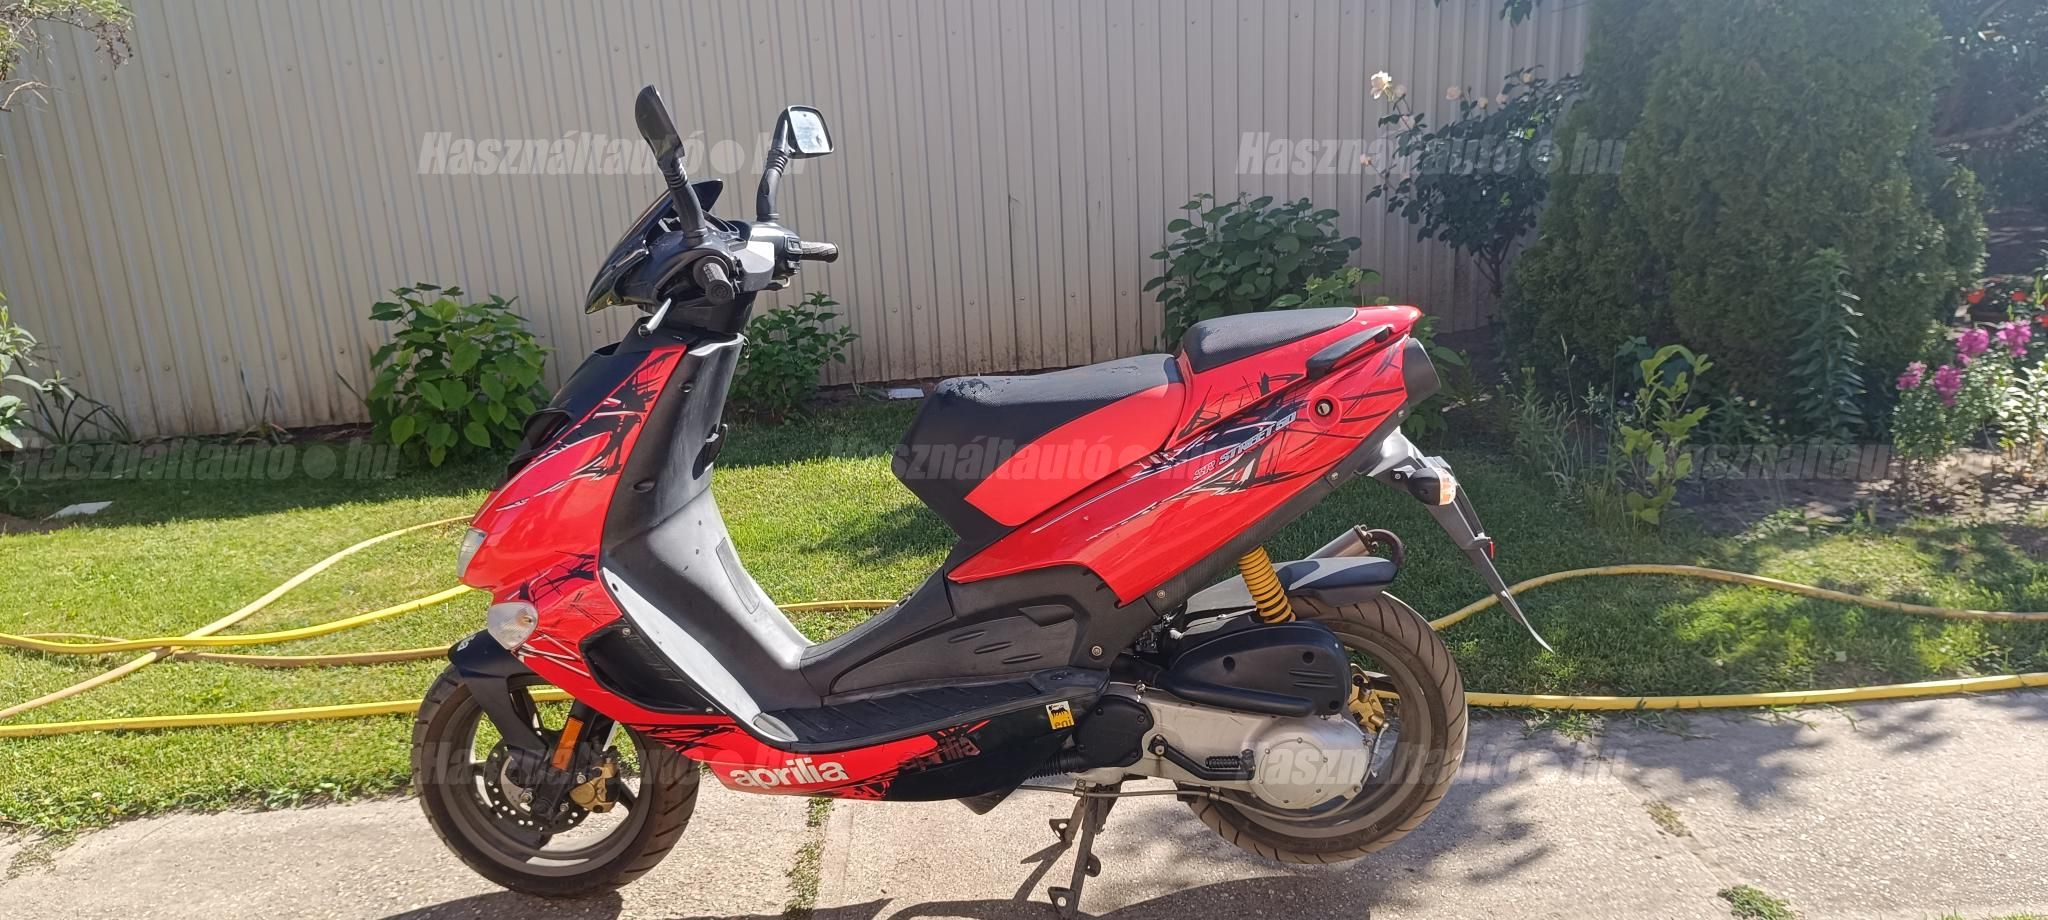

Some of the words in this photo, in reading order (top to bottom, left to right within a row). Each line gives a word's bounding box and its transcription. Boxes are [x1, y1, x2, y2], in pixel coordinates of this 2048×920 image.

[1219, 423, 1276, 465] STREET
[1055, 716, 1074, 728] eni
[729, 757, 850, 789] aprilia
